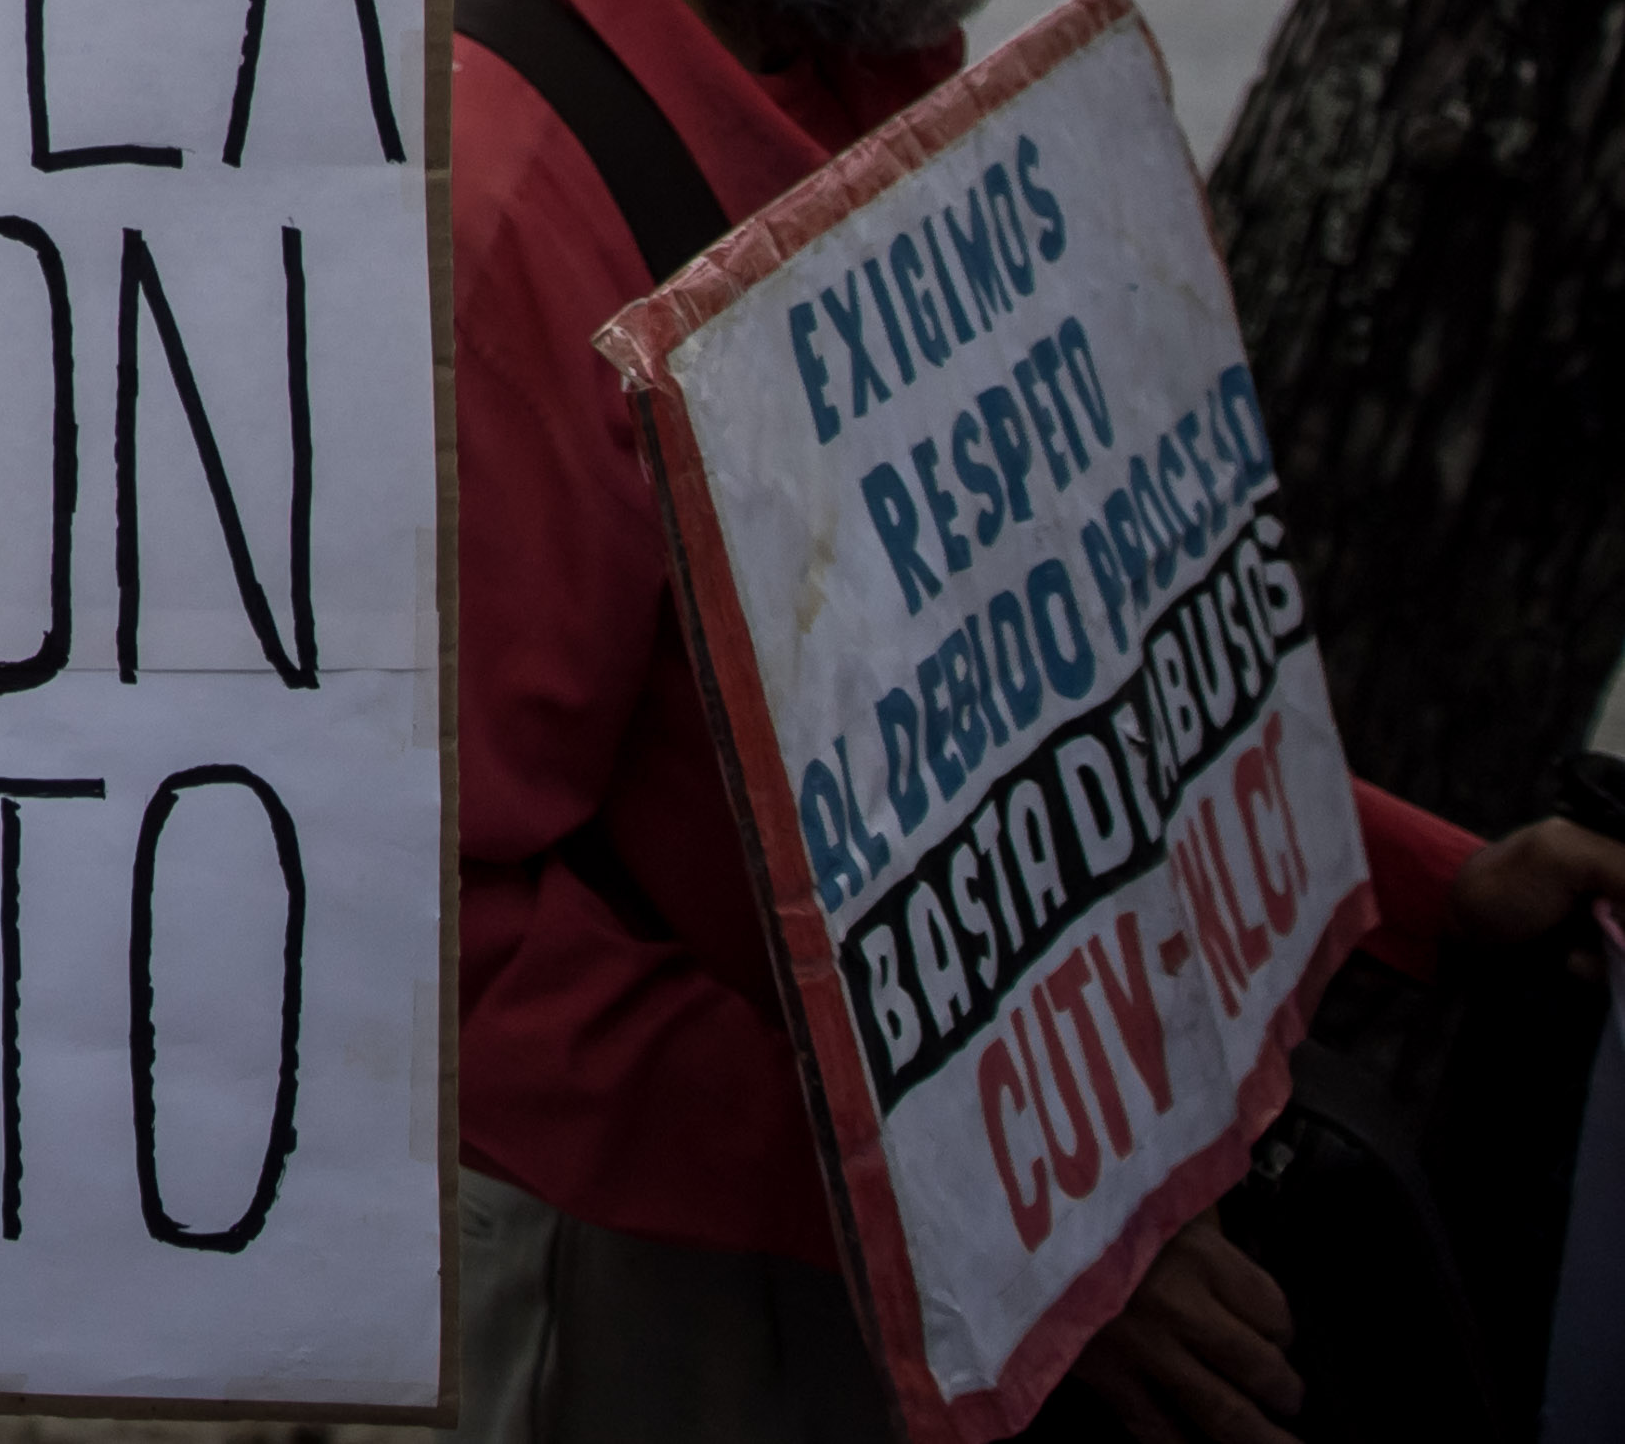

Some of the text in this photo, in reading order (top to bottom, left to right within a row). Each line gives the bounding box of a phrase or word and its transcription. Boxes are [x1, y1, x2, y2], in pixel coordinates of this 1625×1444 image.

[787, 134, 1066, 445] EXIGIMOS
[861, 315, 1117, 614] RESPETO
[797, 733, 889, 913] AL
[882, 551, 1097, 839] DEBIDO
[860, 779, 1068, 1076] BASTA
[1141, 514, 1304, 801] ABUSOS
